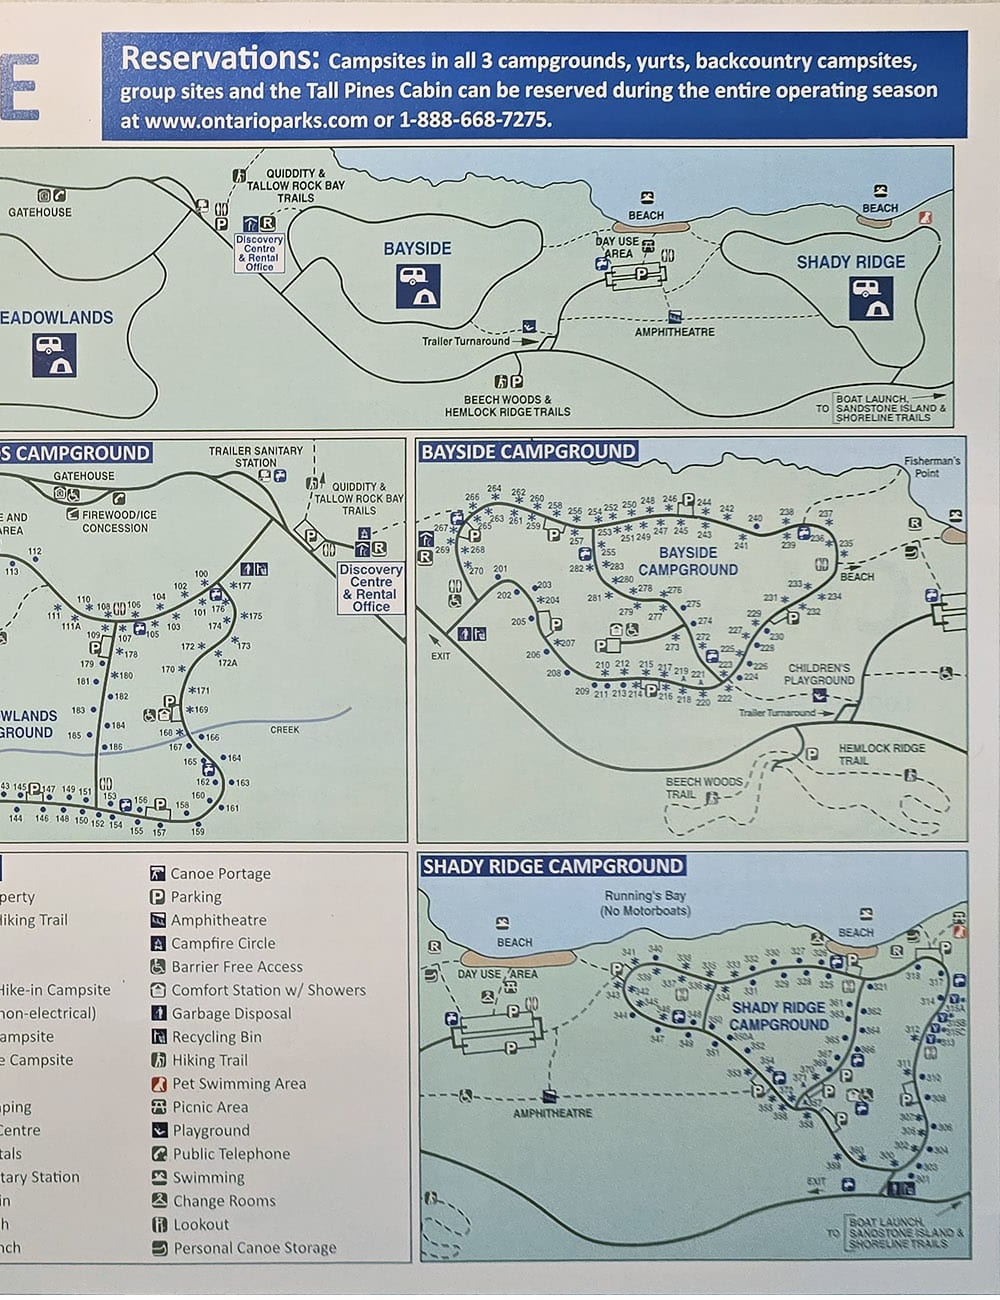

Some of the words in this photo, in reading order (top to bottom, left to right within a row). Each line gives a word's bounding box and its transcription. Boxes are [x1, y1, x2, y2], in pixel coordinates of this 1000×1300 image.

[119, 44, 319, 70] Reservations:
[329, 52, 426, 73] Campsites
[431, 52, 448, 69] in
[454, 51, 476, 69] all
[482, 52, 493, 69] 3
[498, 52, 631, 73] campgrounds,
[636, 54, 690, 73] yurts,
[696, 52, 812, 73] backcountry
[817, 52, 917, 73] campsites,
[121, 114, 140, 129] at
[145, 111, 368, 133] www.ontarioparks.com
[373, 115, 394, 128] or
[400, 111, 552, 128] 1-888-668-7275.
[8, 207, 72, 217] GATEHOUSE
[629, 210, 664, 220] BEACH
[384, 241, 451, 255] BAYSIDE
[797, 255, 851, 269] SHADY
[856, 255, 905, 269] RIDGE
[635, 327, 715, 337] AMPHITHEATRE
[16, 445, 151, 464] CAMPGROUND
[209, 446, 251, 456] TRAILER
[254, 446, 304, 455] SANITARY
[422, 444, 495, 459] BAYSIDE
[501, 443, 635, 459] CAMPGROUND
[905, 456, 961, 466] Fisherman's
[53, 471, 114, 481] GATEHOUSE
[82, 510, 157, 520] FIREWOOD/ICE
[82, 523, 148, 533] CONCESSION
[660, 546, 717, 559] BAYSIDE
[639, 563, 738, 576] CAMPGROUND
[125, 650, 138, 658] 178
[120, 671, 134, 680] 180
[784, 676, 855, 686] PLAYGROUND
[270, 725, 299, 734] CREEK
[839, 743, 891, 753] HEMLOCK
[893, 743, 925, 753] RIDGE
[424, 859, 484, 874] SHADY
[490, 859, 544, 874] RIDGE
[549, 858, 683, 874] CAMPGROUND
[171, 868, 214, 880] Canoe
[219, 867, 271, 882] Portage
[665, 890, 686, 903] Bay
[600, 906, 620, 918] (No
[624, 905, 691, 916] Motorboats)
[39, 913, 68, 926] Trail
[47, 984, 111, 998] Campsite
[732, 1001, 779, 1014] SHADY
[783, 1001, 825, 1014] RIDGE
[730, 1019, 829, 1034] CAMPGROUND
[173, 1077, 195, 1090] Pet
[199, 1077, 271, 1092] Swimming
[275, 1077, 306, 1090] Area
[513, 1108, 592, 1118] AMPHITHEATRE
[174, 1241, 233, 1255] Personal
[237, 1242, 280, 1254] Canoe
[285, 1241, 337, 1256] Storage
